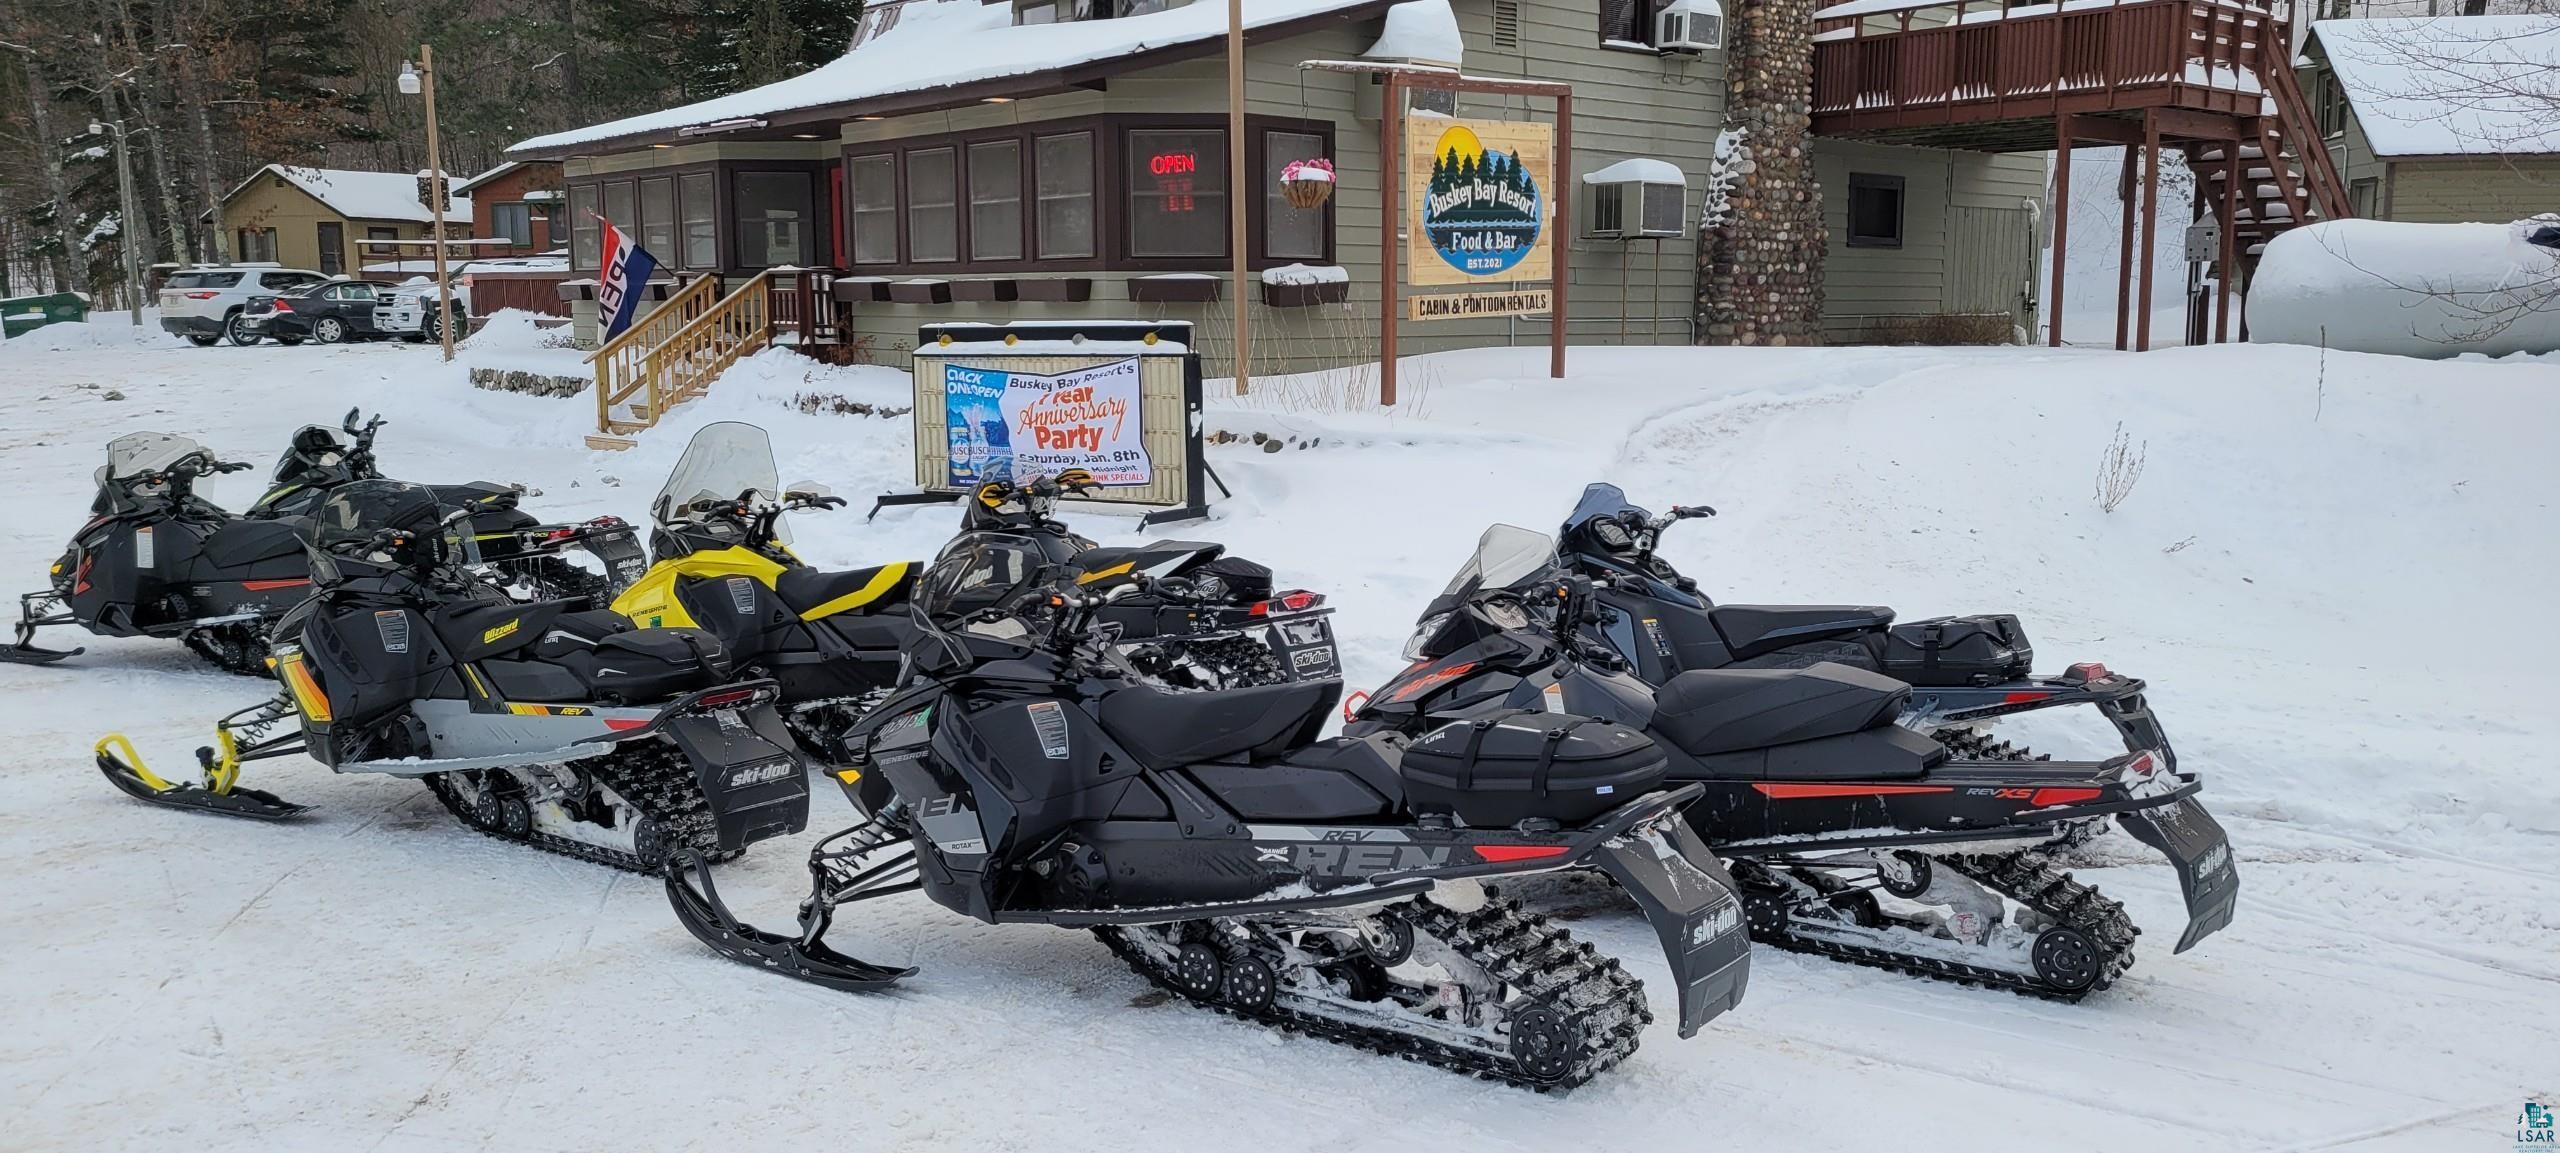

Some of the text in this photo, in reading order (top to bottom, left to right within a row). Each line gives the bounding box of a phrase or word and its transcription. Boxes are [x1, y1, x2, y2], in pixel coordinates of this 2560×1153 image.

[1151, 154, 1195, 174] OPEN
[1429, 178, 1537, 218] Buskey Bay Resort
[1452, 231, 1517, 250] Food & Bar
[1419, 294, 1546, 316] CABIN & PONTOON RENTALS
[1010, 364, 1135, 392] Buskey Bay Resort's
[1017, 397, 1128, 441] Anniversary
[1034, 424, 1103, 451] Party
[1019, 450, 1140, 466] Saturday, Jan. 8th
[1091, 464, 1138, 473] Midnight
[1111, 472, 1144, 481] SPECIALS
[484, 618, 519, 643] Blizzard
[1295, 652, 1329, 666] ski-doo
[560, 707, 584, 716] REV
[880, 750, 929, 766] RENEGADE
[730, 763, 791, 786] ski-doo
[1321, 831, 1374, 841] REV
[951, 842, 972, 850] ROTAX
[1694, 906, 1737, 945] ski-doo
